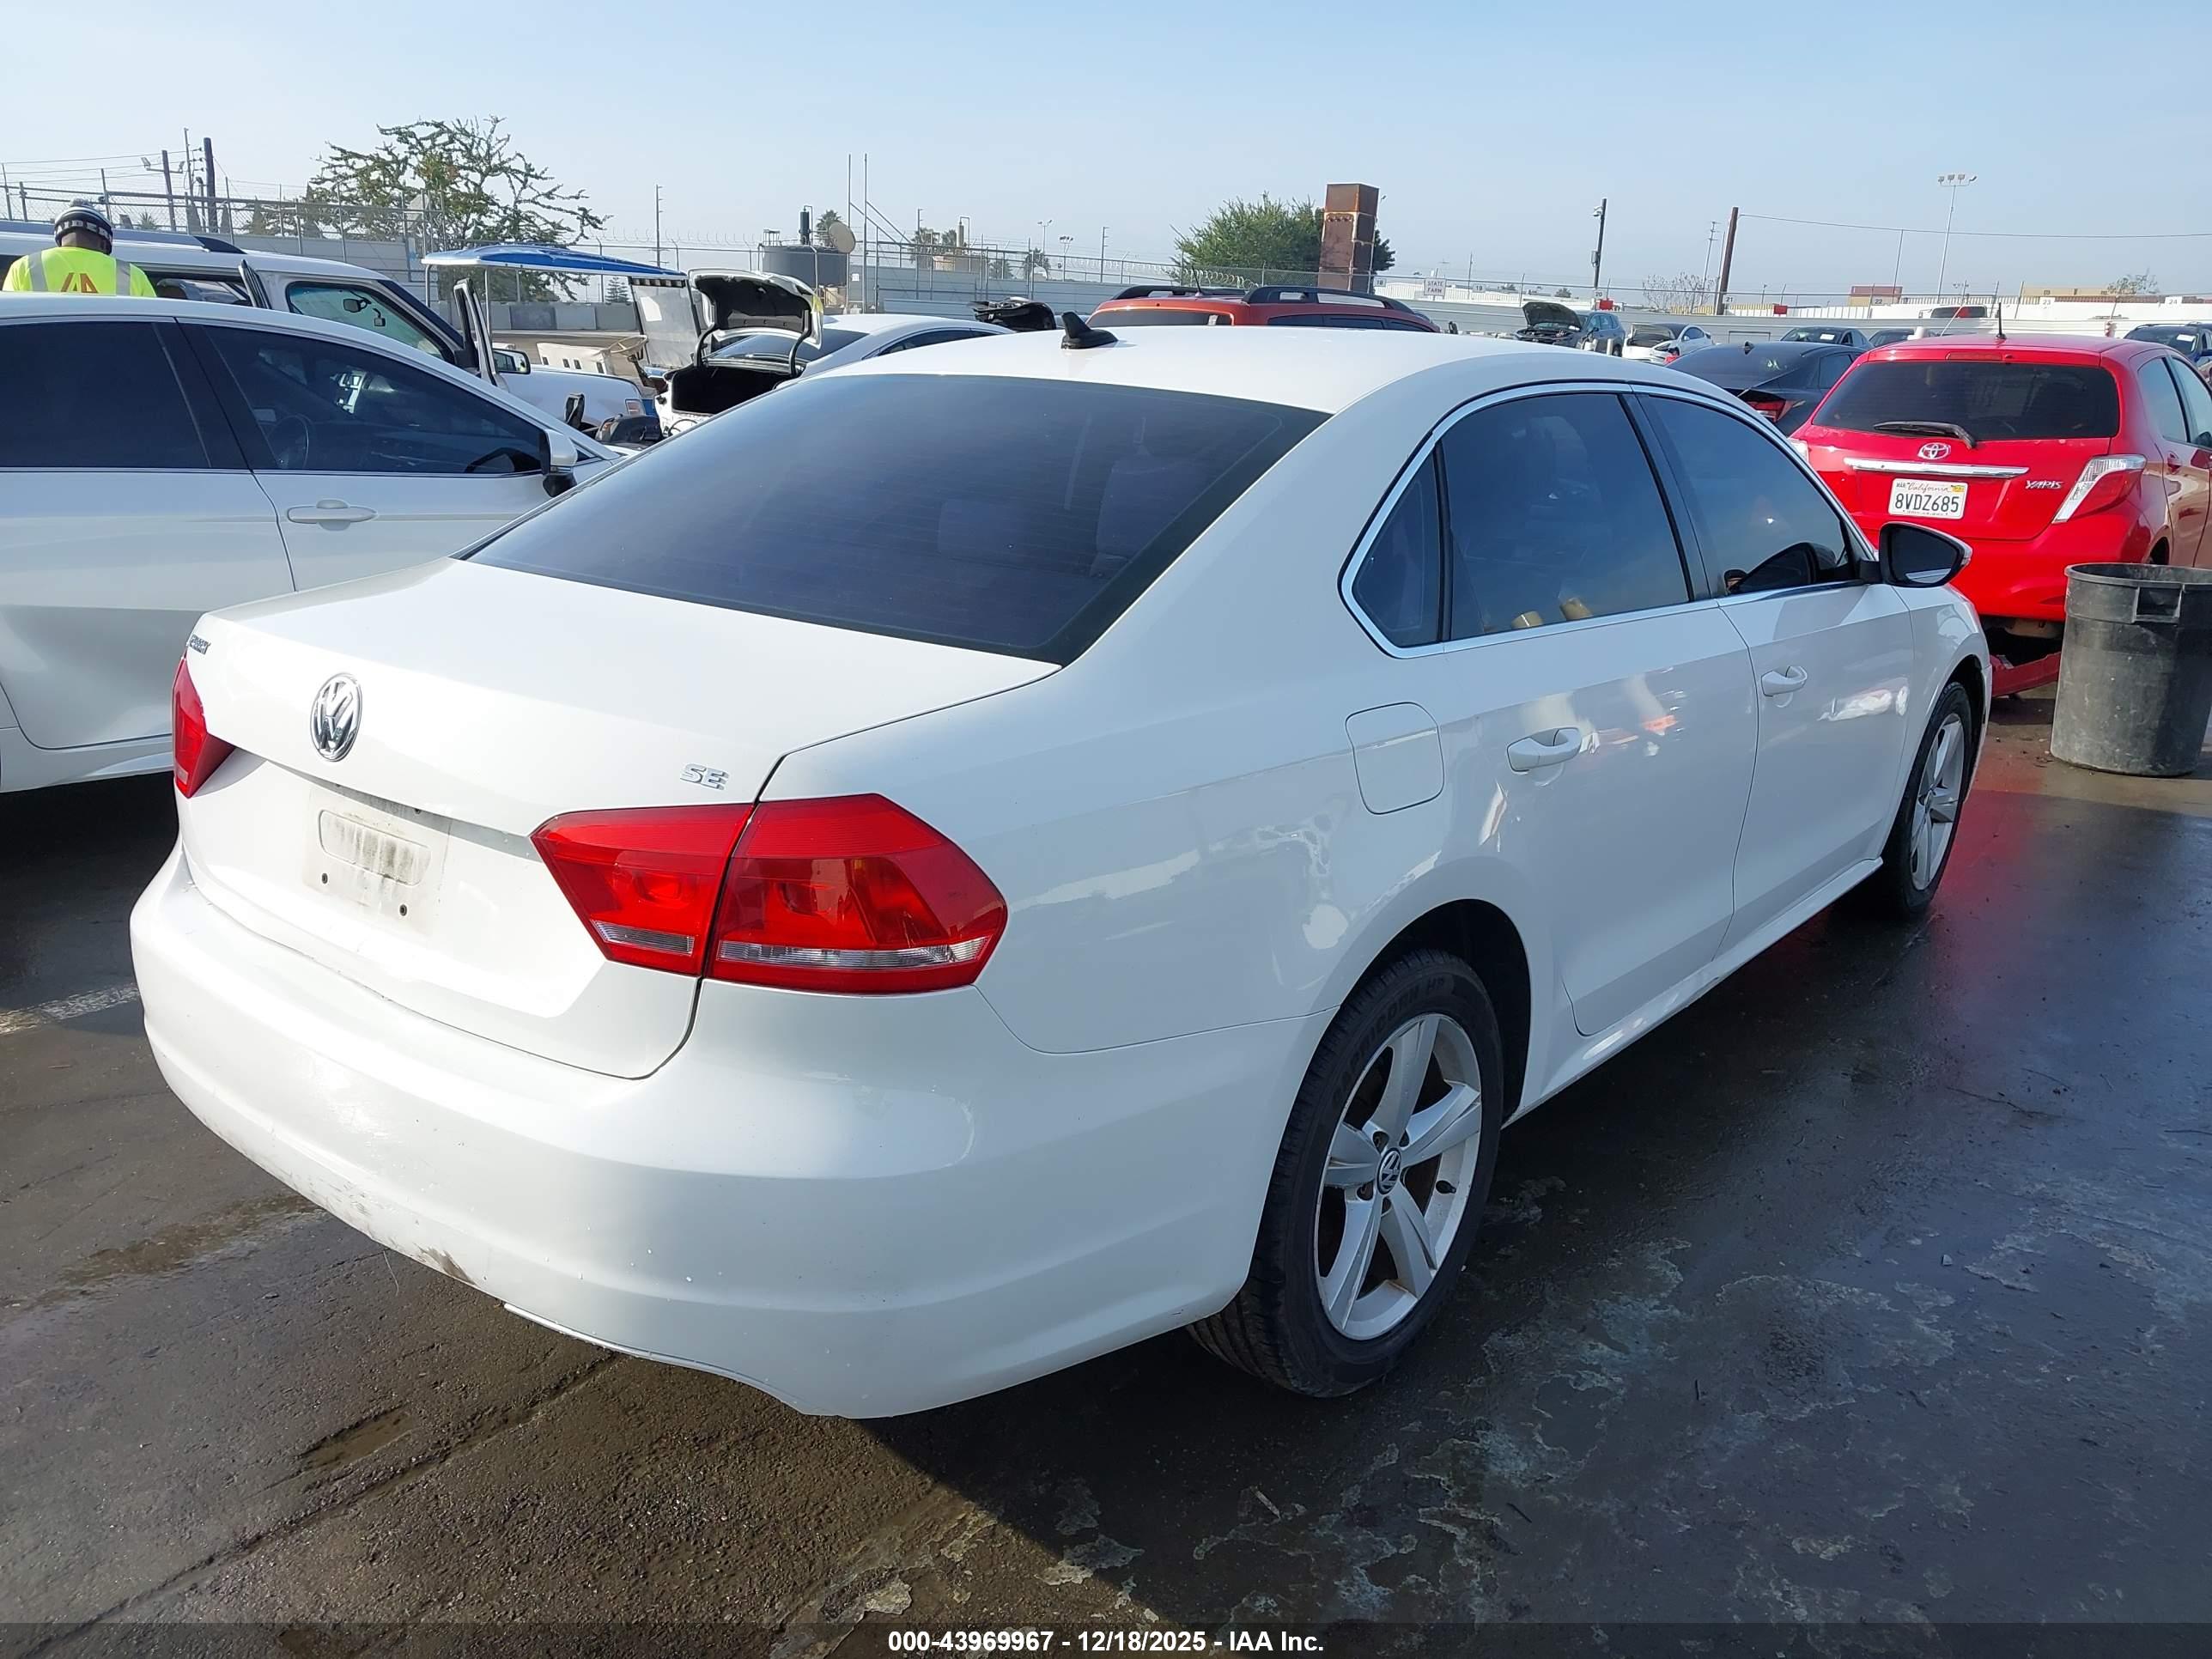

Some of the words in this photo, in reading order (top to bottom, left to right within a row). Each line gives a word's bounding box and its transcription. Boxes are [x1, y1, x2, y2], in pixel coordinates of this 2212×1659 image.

[1907, 482, 1949, 494] California
[2025, 480, 2063, 489] YARIS
[1894, 493, 1960, 513] 8VDZ685
[680, 763, 729, 790] SE
